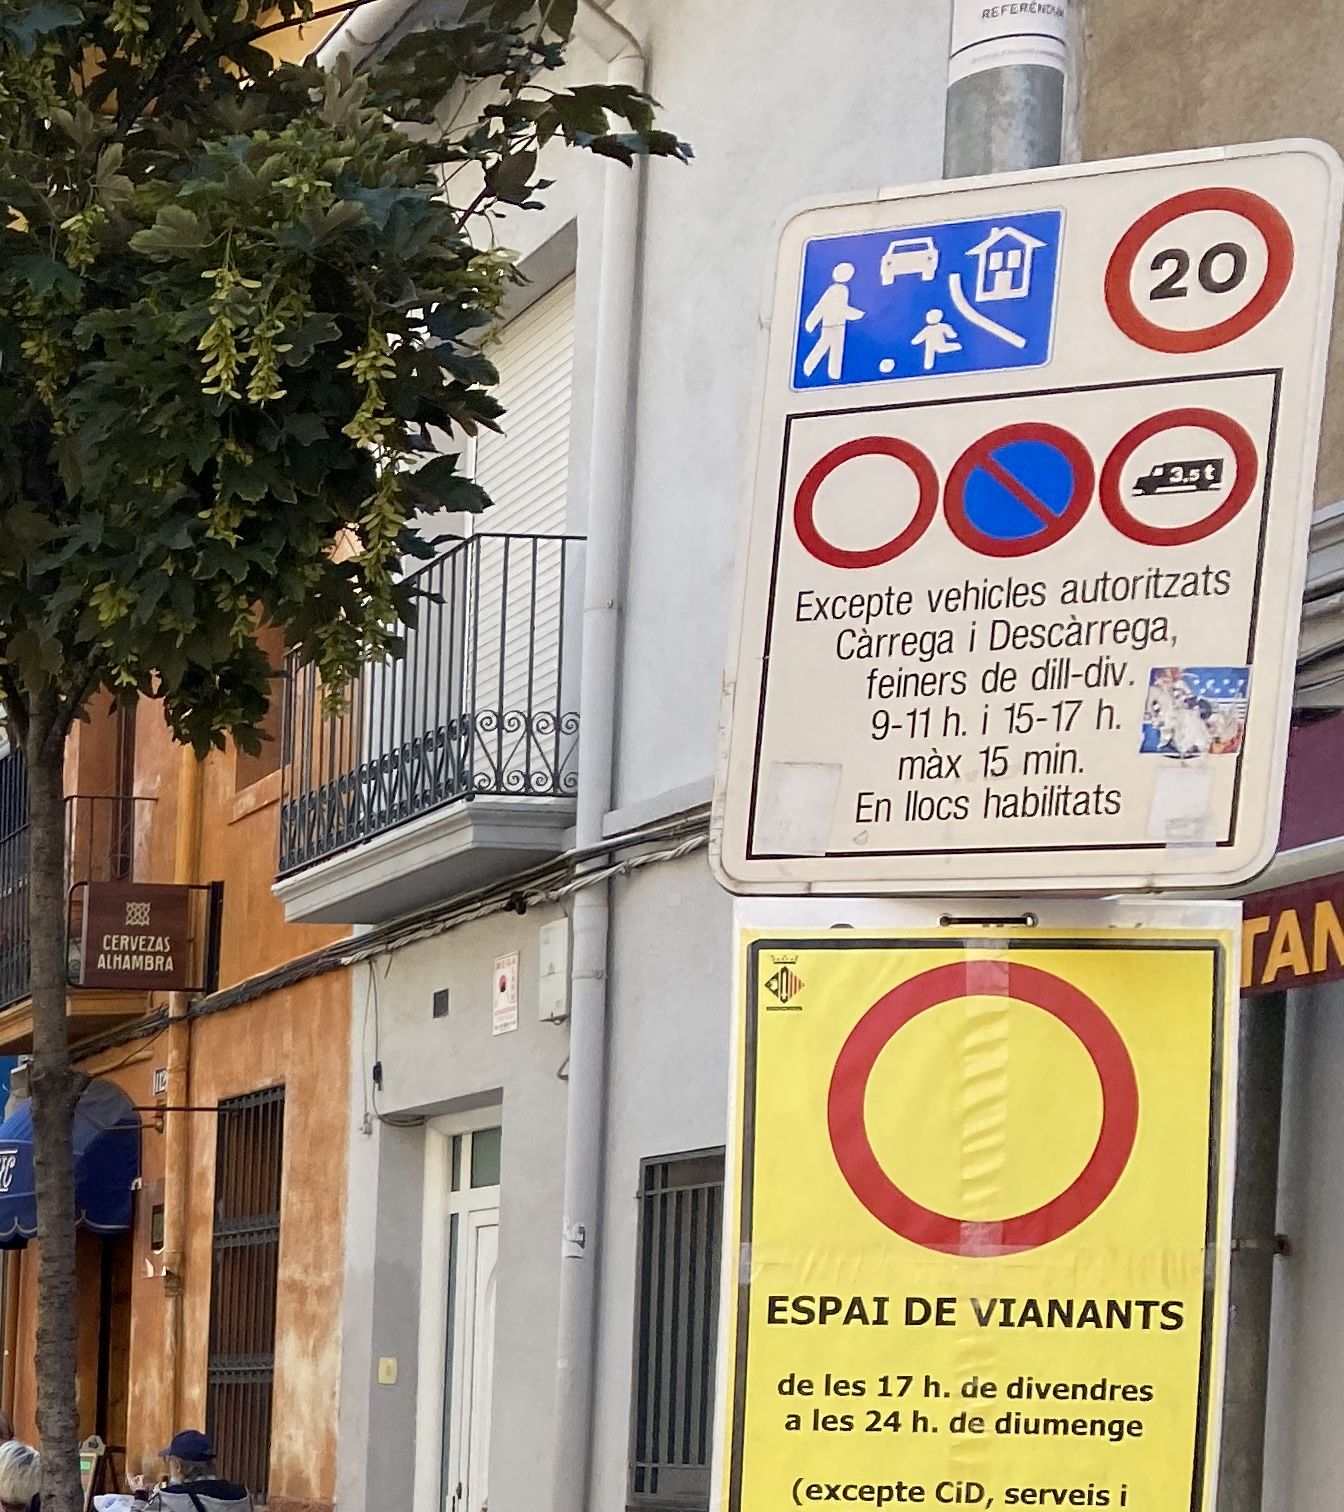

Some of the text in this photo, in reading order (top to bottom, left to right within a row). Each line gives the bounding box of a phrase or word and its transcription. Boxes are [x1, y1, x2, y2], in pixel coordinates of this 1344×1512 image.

[1150, 243, 1248, 300] 20
[1204, 463, 1216, 481] t
[796, 565, 1230, 624] Excepte vehicles autoritzats
[837, 615, 1176, 662] Càrrega i Descàrrega,
[867, 656, 1133, 699] feiners de dill-div.
[872, 698, 1120, 740] 9-11 h. i 15-17 h.
[899, 743, 1083, 780] màx 15 min.
[856, 784, 1121, 822] En llocs habilitats
[103, 935, 171, 952] CERVEZAS
[97, 954, 174, 972] ALHAMBRA
[768, 1296, 1185, 1331] ESPAI DE VIANANTS
[778, 1373, 1153, 1401] de les 17 h. de divendres
[785, 1409, 1142, 1441] a les 24 h. de diumenge
[793, 1478, 1126, 1509] (excepte CiD, serveis i
